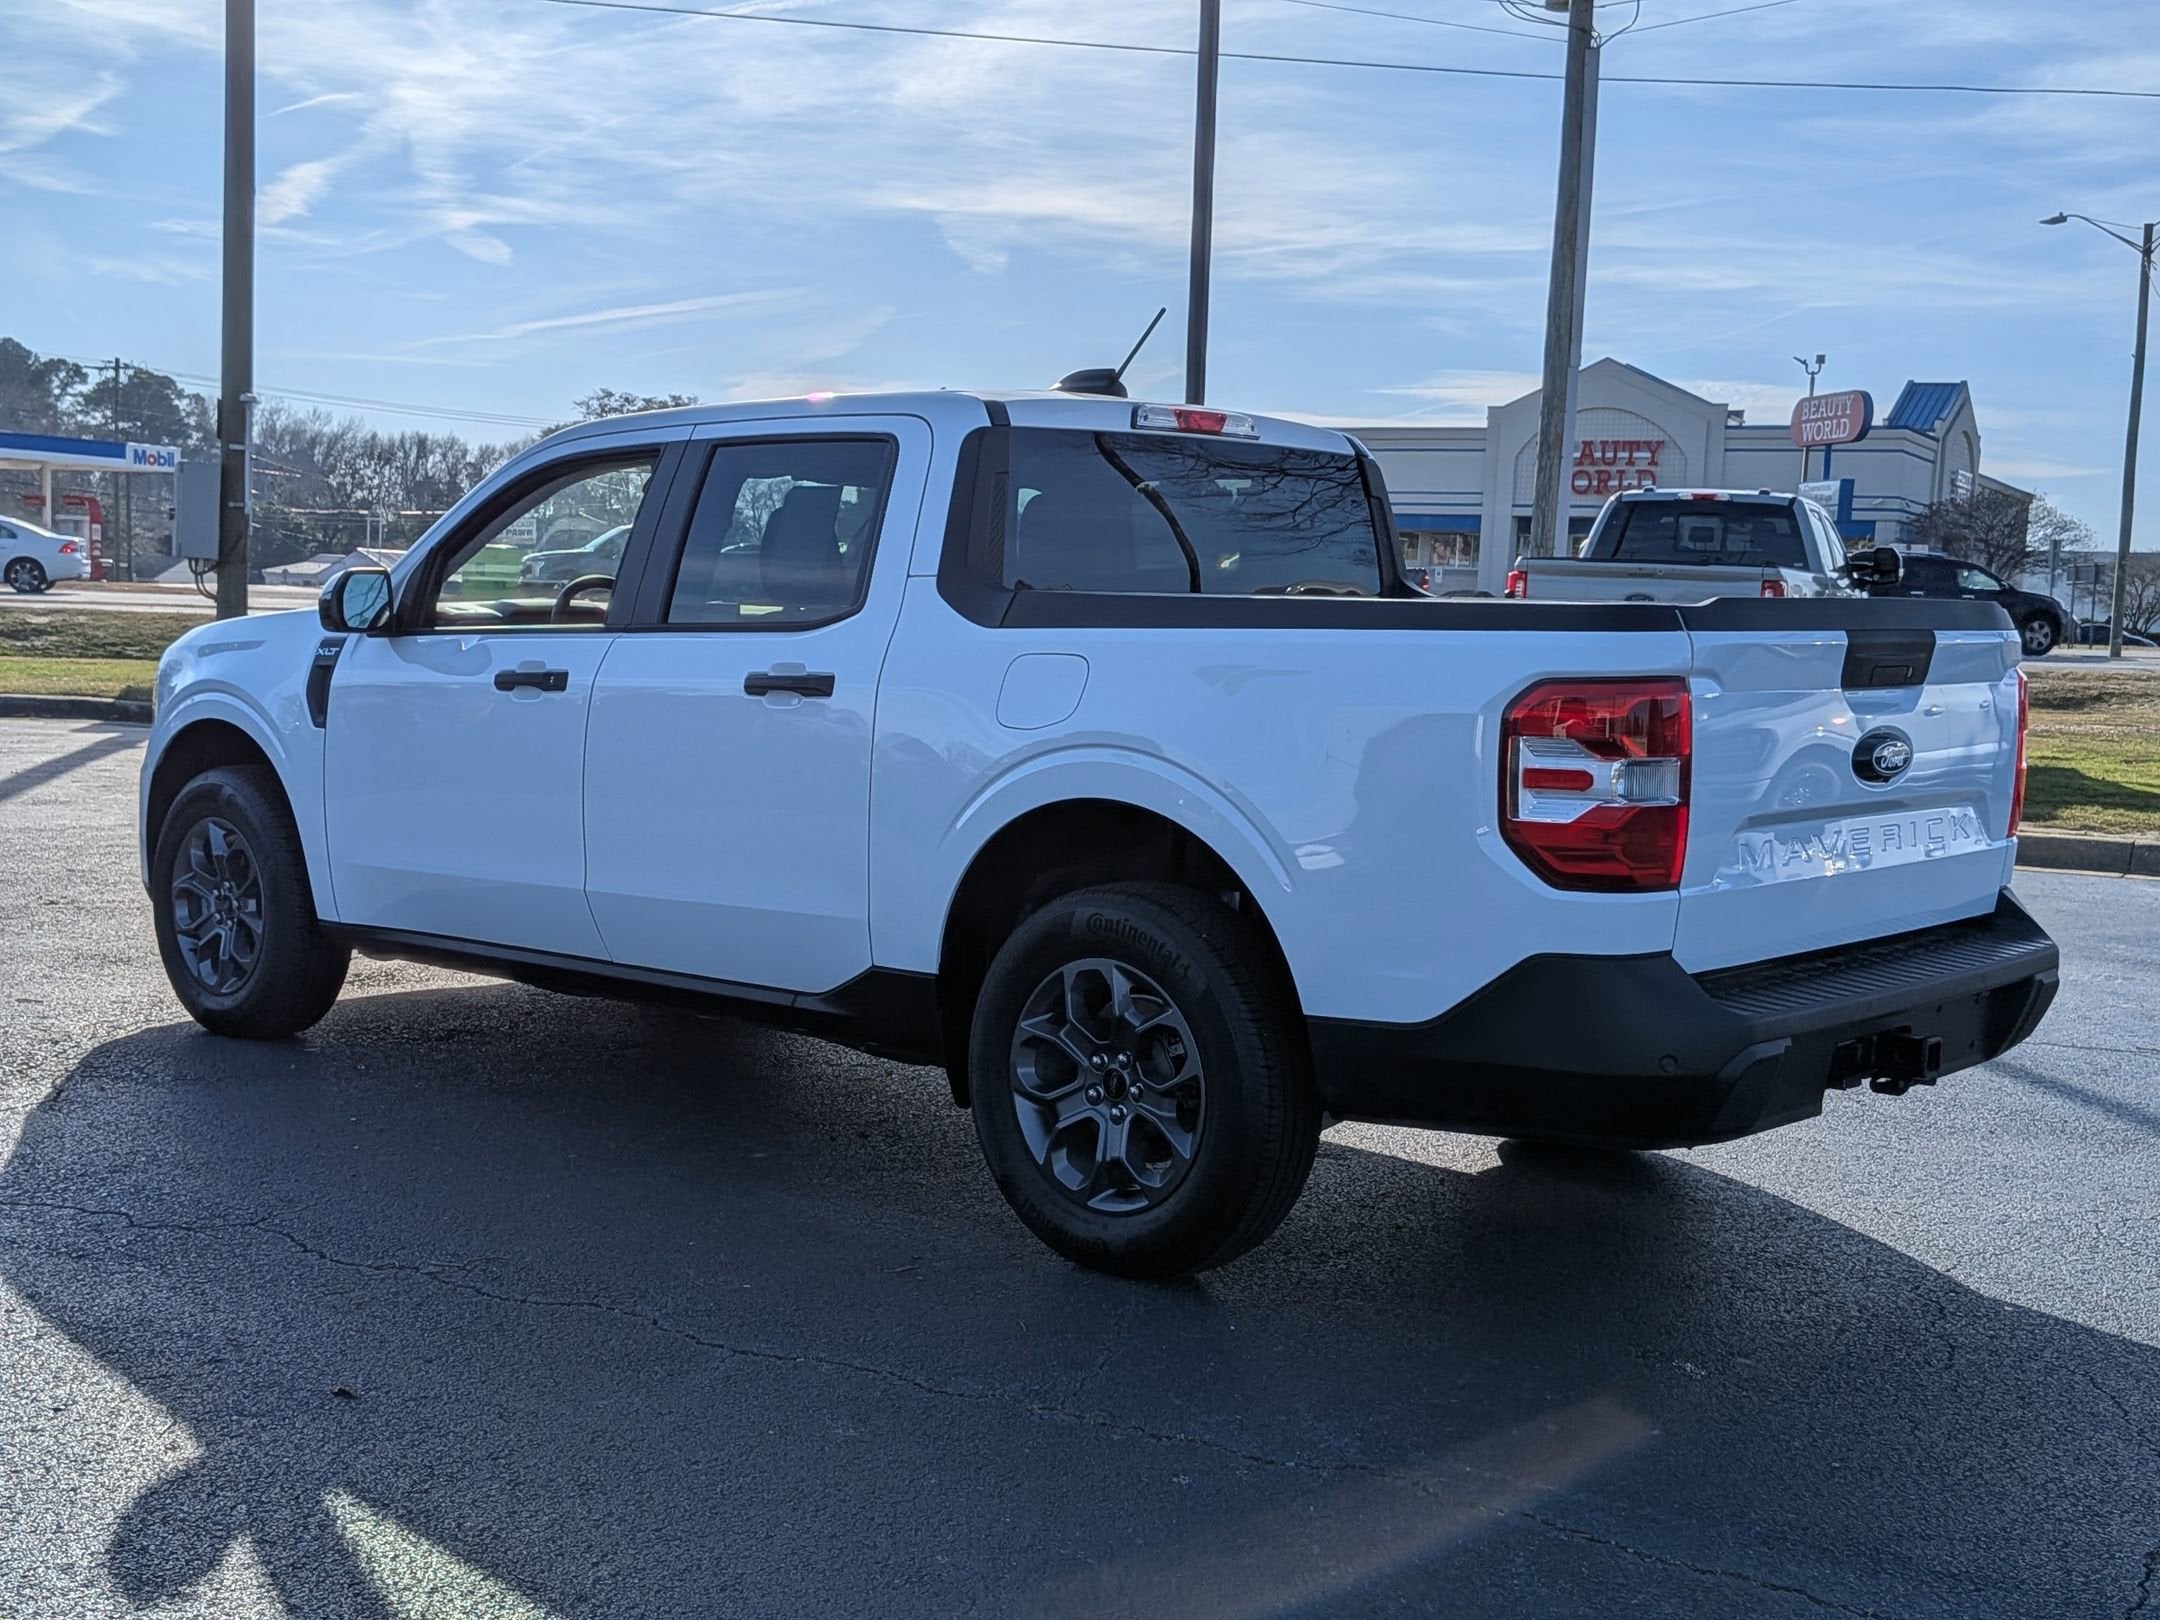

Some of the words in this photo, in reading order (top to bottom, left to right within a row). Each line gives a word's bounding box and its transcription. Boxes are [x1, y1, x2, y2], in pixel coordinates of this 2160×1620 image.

[1801, 395, 1854, 420] BEAUTY
[1802, 418, 1850, 443] WORLD
[133, 448, 175, 468] Mobil
[1573, 439, 1665, 466] AUTY
[1570, 469, 1657, 495] ORLD
[505, 528, 534, 537] PAWN
[316, 647, 340, 656] XLT
[1878, 744, 1908, 769] Ford
[1738, 813, 1970, 873] MAVERICK
[1086, 911, 1183, 968] Continental
